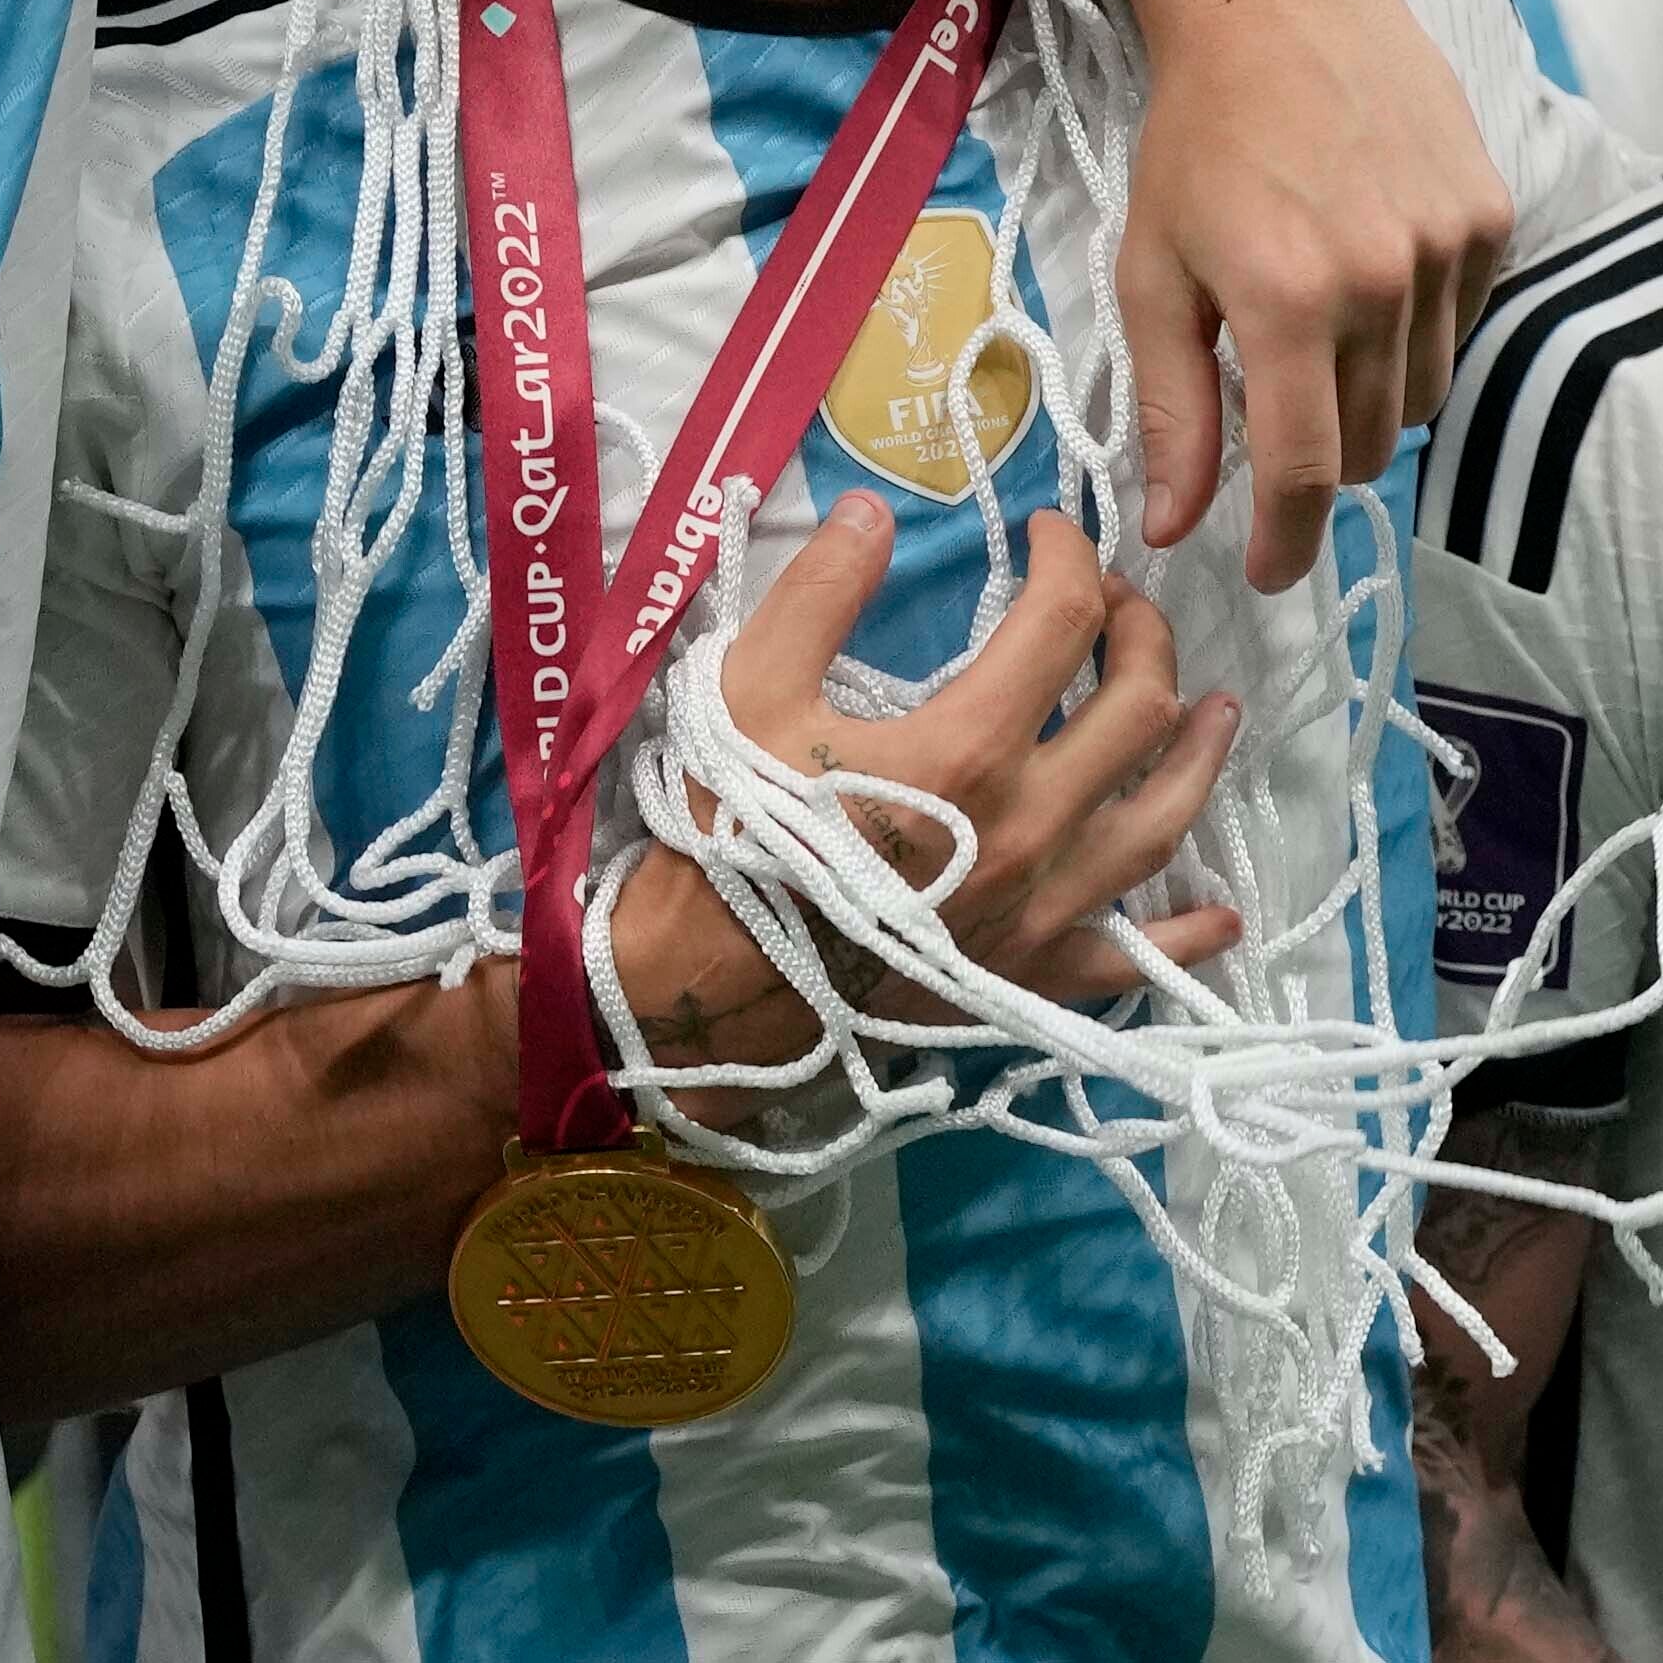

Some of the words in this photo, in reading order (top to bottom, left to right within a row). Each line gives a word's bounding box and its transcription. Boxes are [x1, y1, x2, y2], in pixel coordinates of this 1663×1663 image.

[871, 432, 922, 450] WORLD
[926, 415, 1009, 440] CHAIONS
[915, 439, 960, 463] 202
[526, 561, 567, 658] CUP
[1483, 892, 1526, 912] CUP
